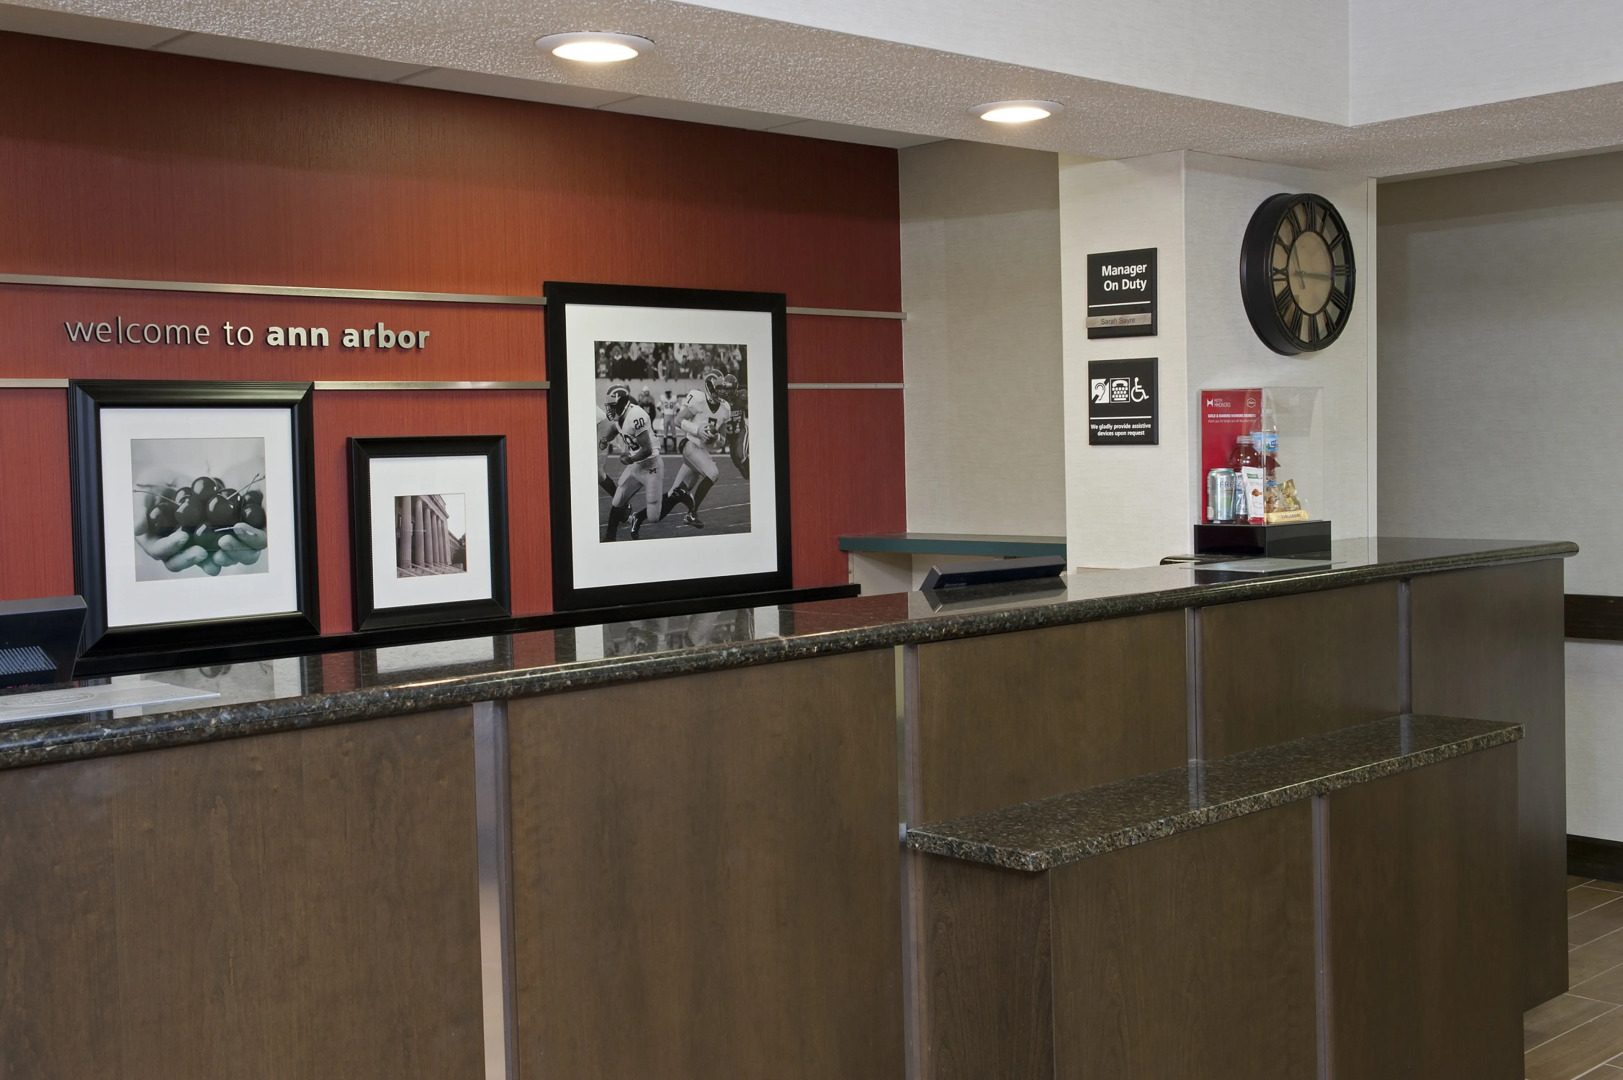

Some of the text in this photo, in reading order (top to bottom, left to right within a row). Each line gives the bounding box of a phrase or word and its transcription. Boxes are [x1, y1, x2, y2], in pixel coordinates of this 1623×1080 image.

[1102, 264, 1147, 277] Manager
[1104, 278, 1147, 291] On Duty
[64, 316, 430, 350] welcome to ann arbor
[633, 417, 645, 430] 20
[649, 467, 657, 475] M
